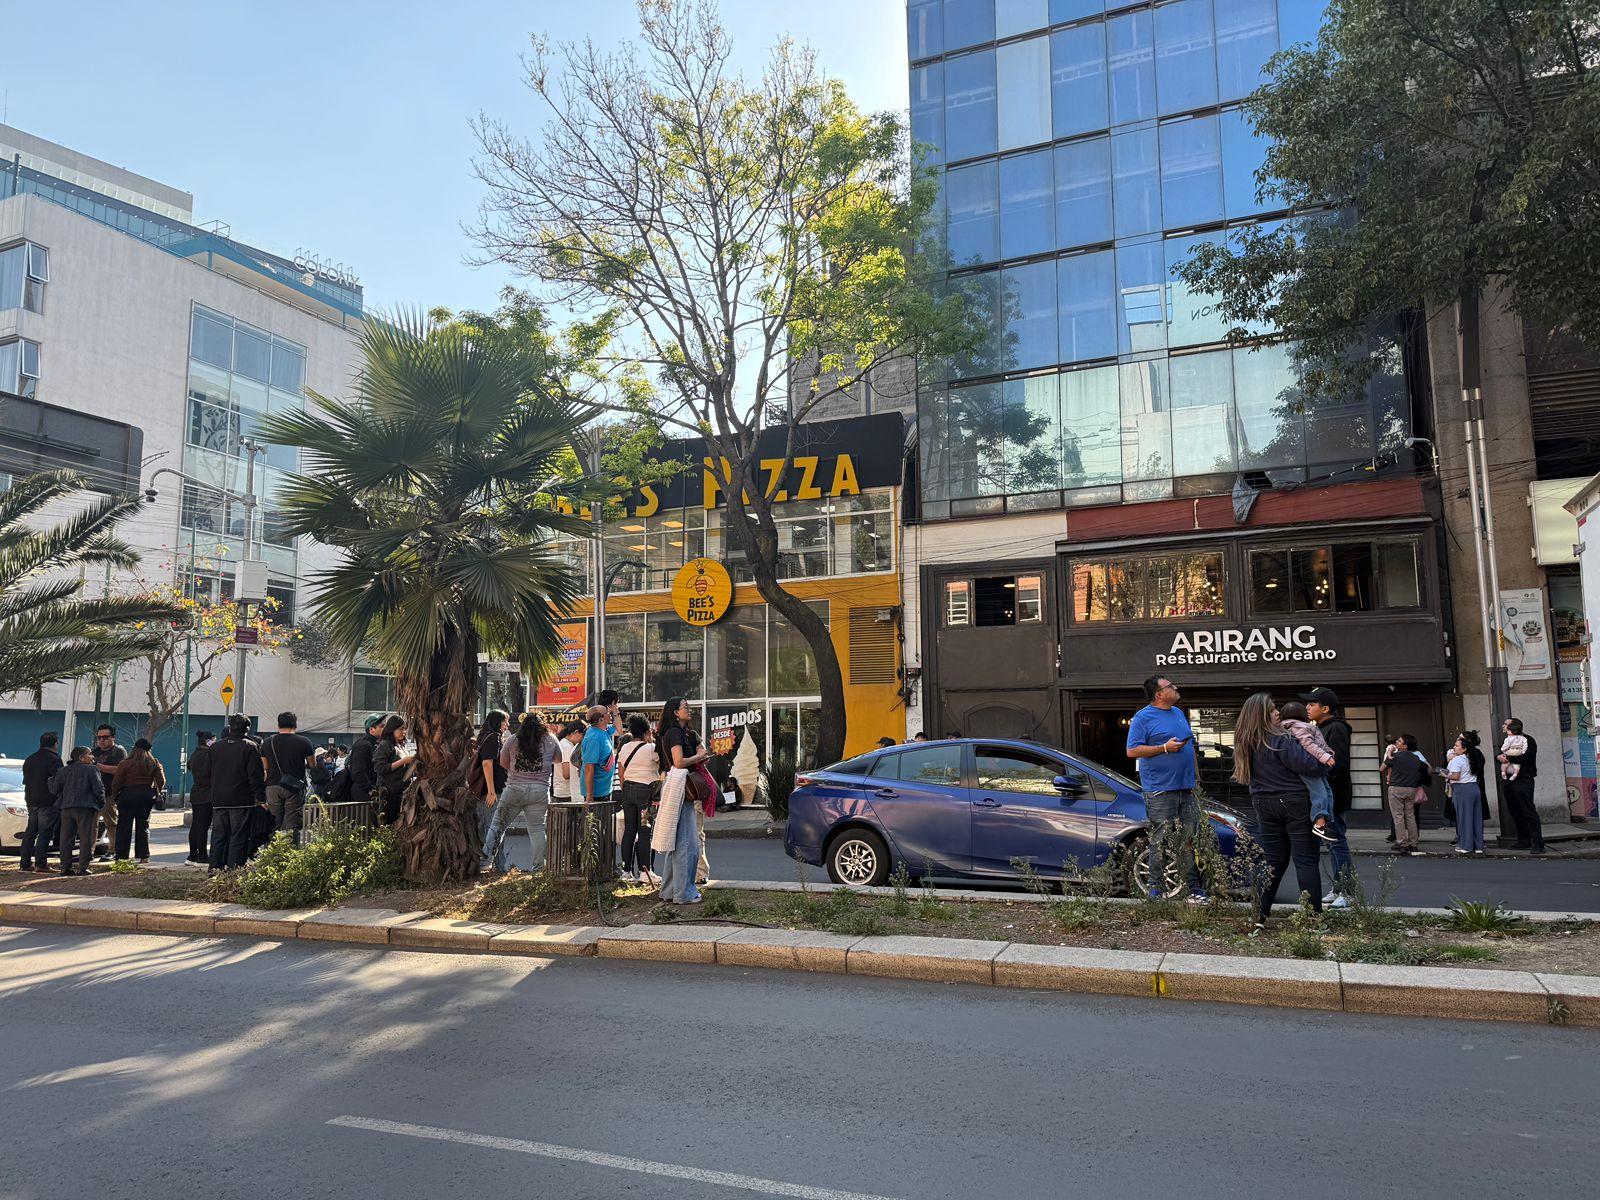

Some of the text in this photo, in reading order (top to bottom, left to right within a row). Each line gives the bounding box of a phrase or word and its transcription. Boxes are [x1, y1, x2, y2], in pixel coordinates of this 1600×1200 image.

[293, 255, 360, 289] COLONY
[703, 453, 860, 510] PZZA
[688, 595, 715, 609] BEE'S
[687, 609, 715, 622] PIZZA
[1169, 625, 1317, 654] ARIRANG
[1156, 648, 1337, 666] Restaurante Coreano
[710, 709, 762, 731] HELADOS
[713, 729, 731, 739] DESDE
[713, 738, 733, 753] $20
